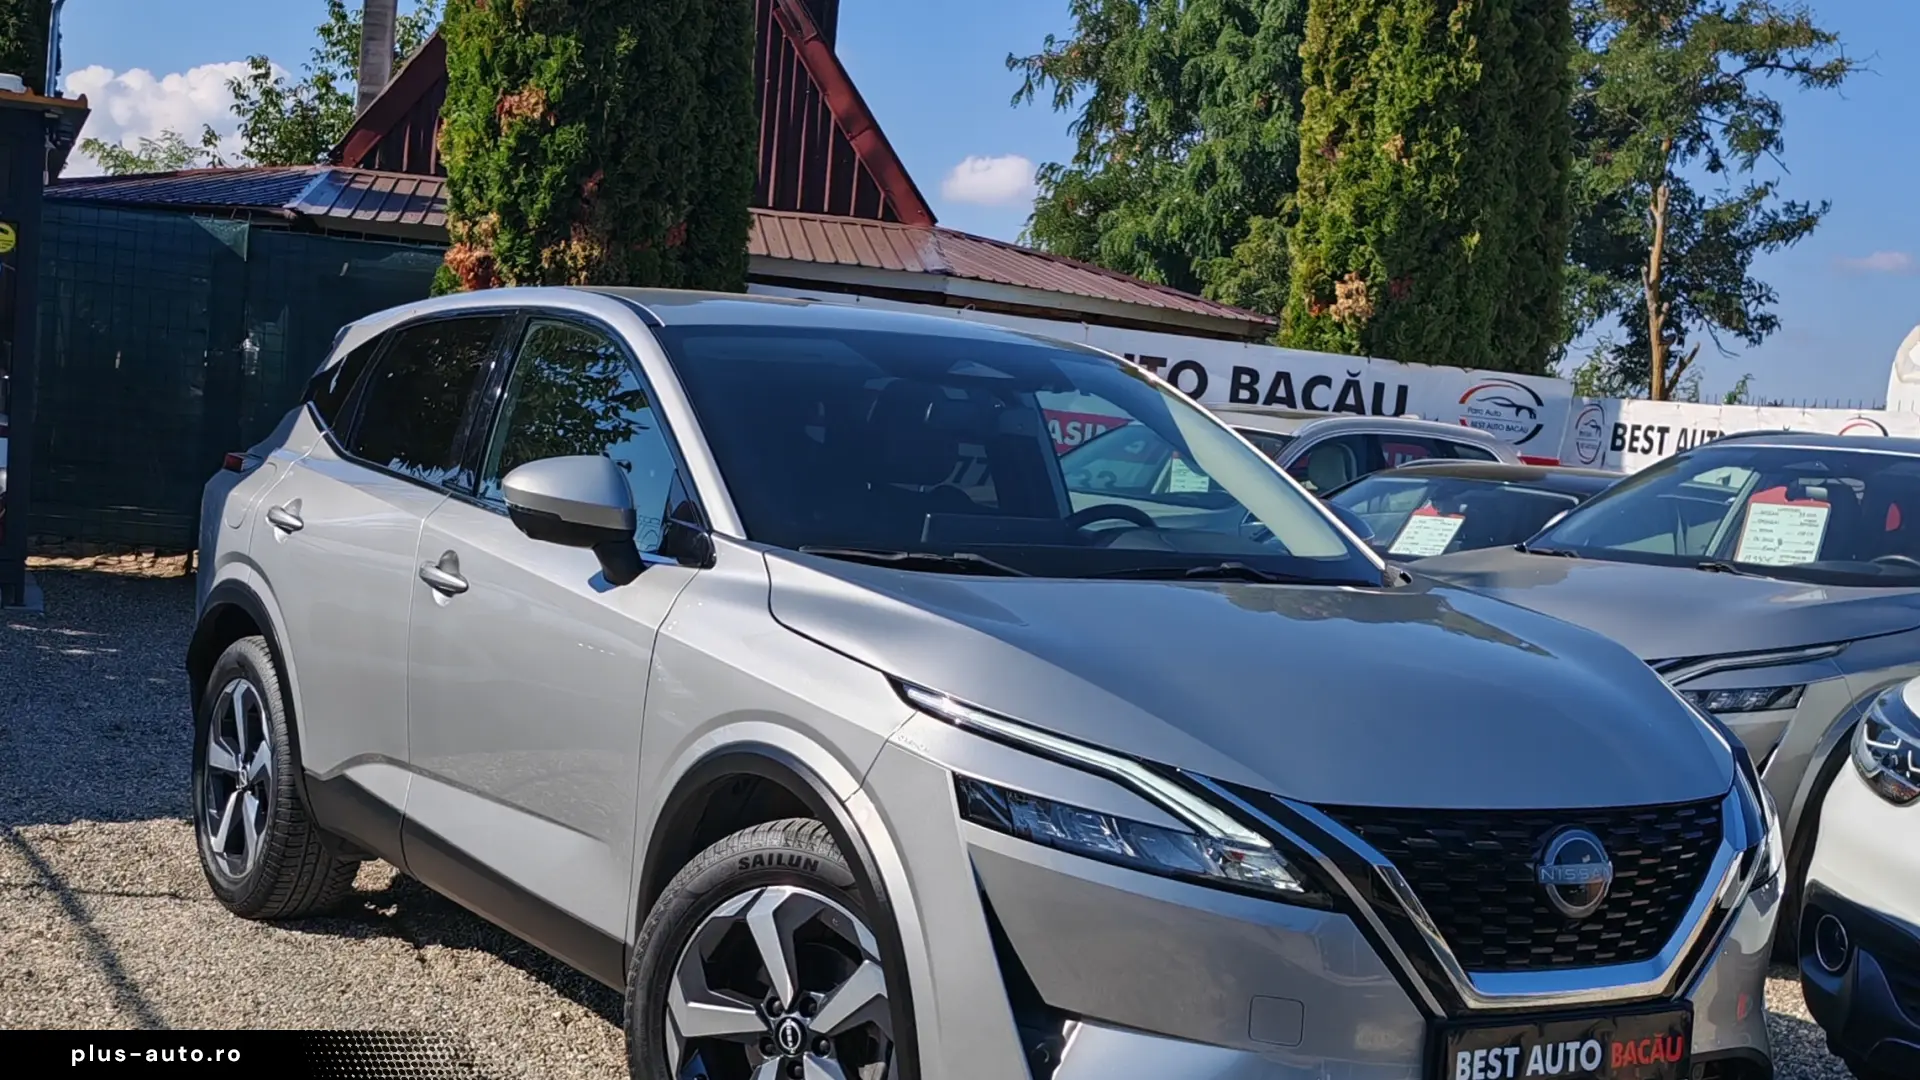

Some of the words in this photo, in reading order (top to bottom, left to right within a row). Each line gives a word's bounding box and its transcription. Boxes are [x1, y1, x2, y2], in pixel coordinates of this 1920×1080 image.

[1229, 366, 1408, 416] BACĂU
[1470, 420, 1486, 429] BEST
[1486, 423, 1505, 431] AUTO
[1610, 422, 1670, 456] BEST
[738, 853, 819, 872] SAILUN
[1541, 866, 1611, 881] NISSAN
[1456, 1047, 1520, 1080] BEST
[1525, 1039, 1602, 1077] AUTO
[1611, 1032, 1684, 1069] BACĂU
